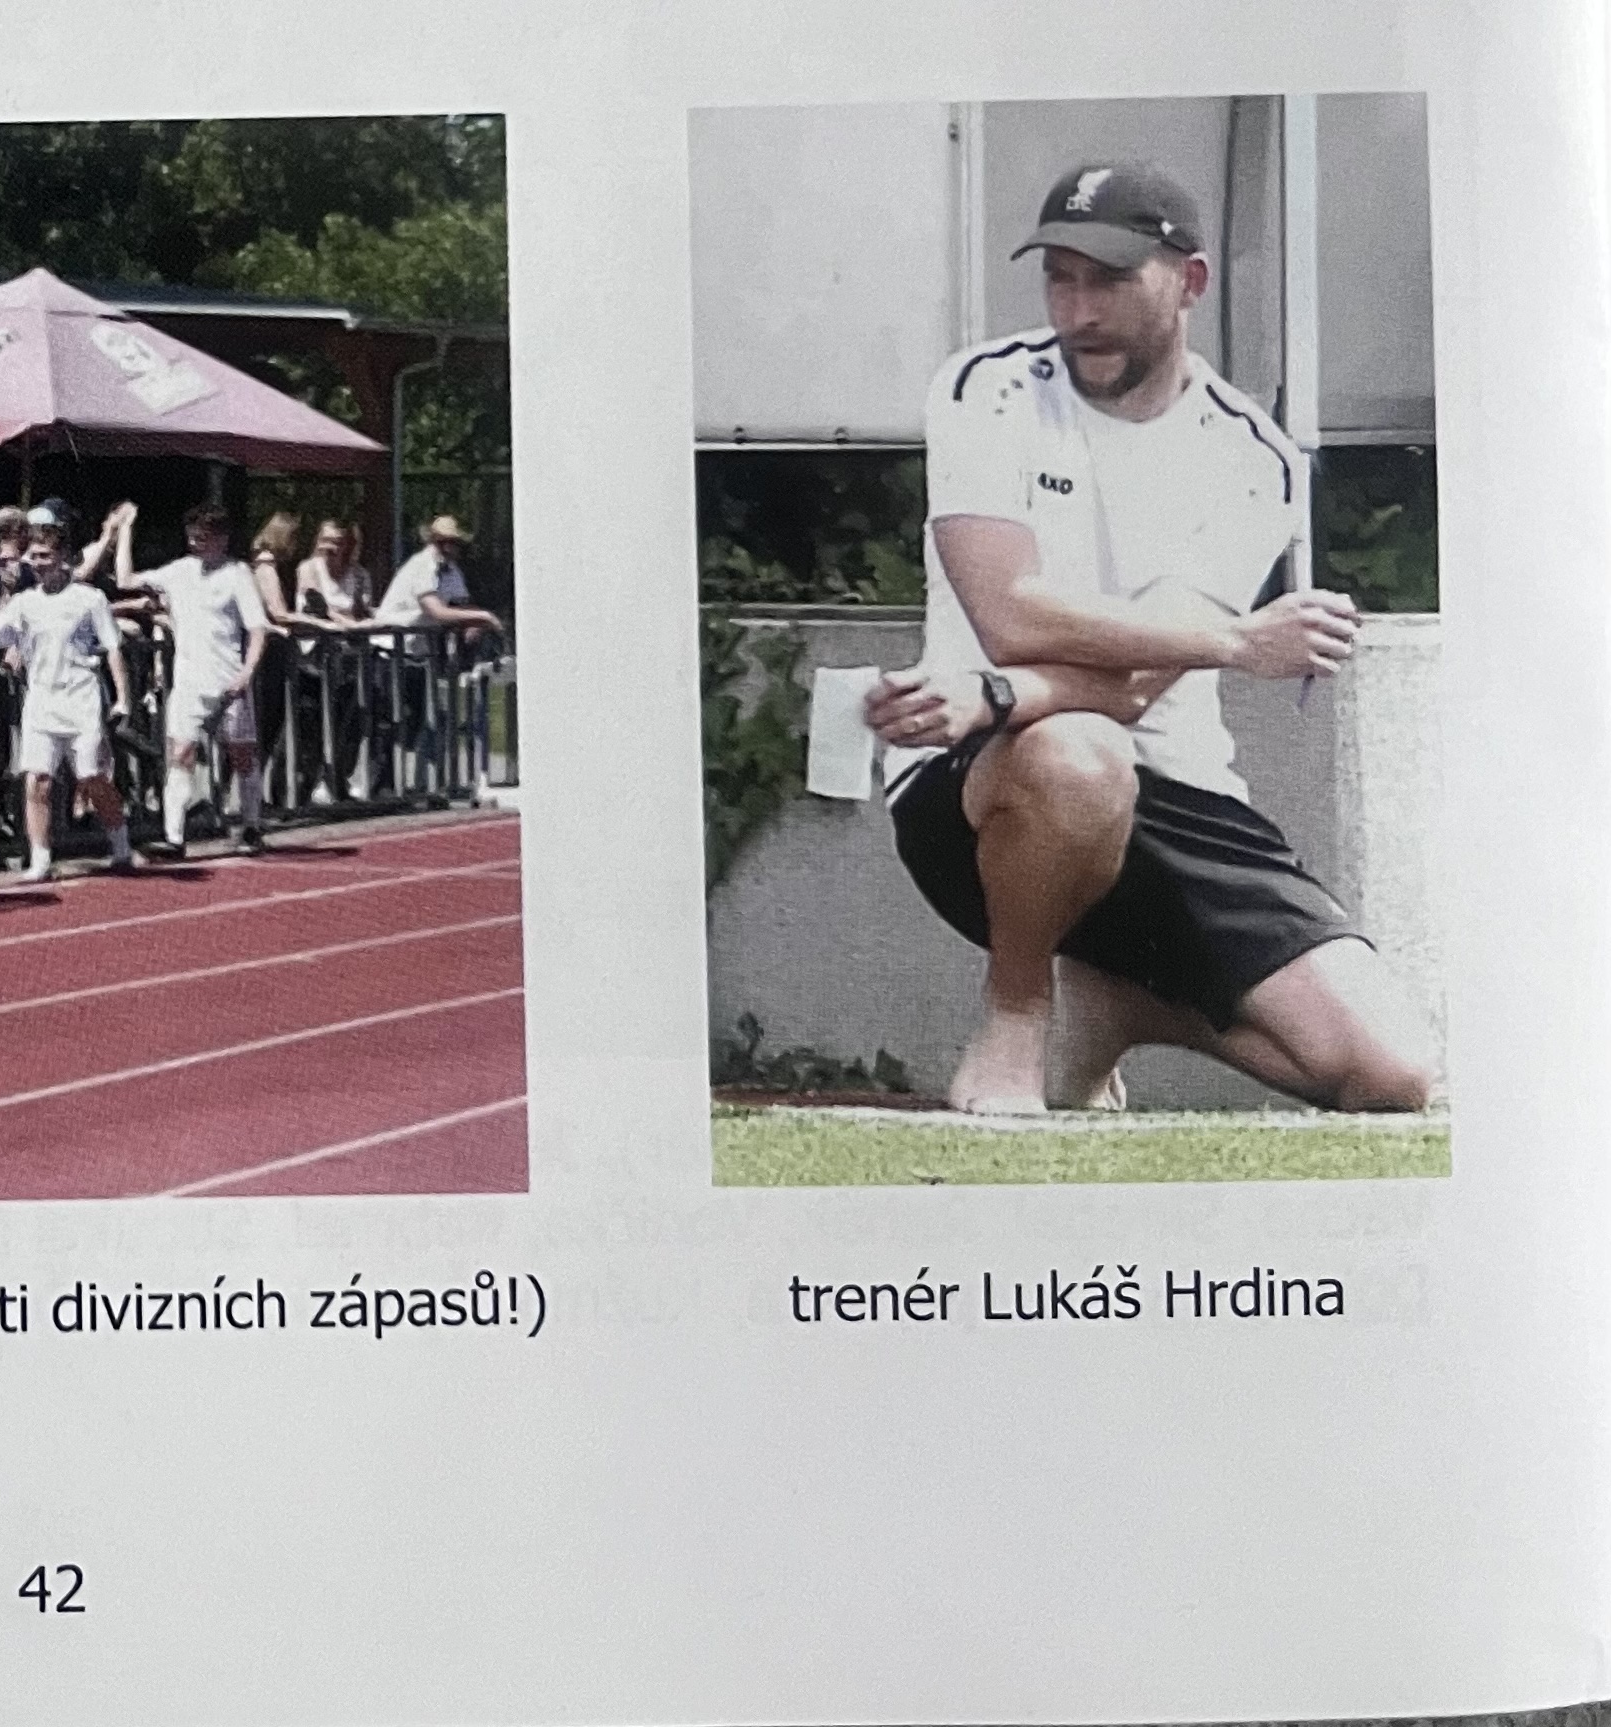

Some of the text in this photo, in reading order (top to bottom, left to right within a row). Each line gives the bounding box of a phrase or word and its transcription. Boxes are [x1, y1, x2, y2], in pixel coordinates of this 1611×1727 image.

[52, 1275, 286, 1333] divizních
[310, 1270, 546, 1340] zápasů!)
[788, 1264, 1344, 1323] trenér Lukáš Hrdina
[18, 1564, 86, 1613] 42
